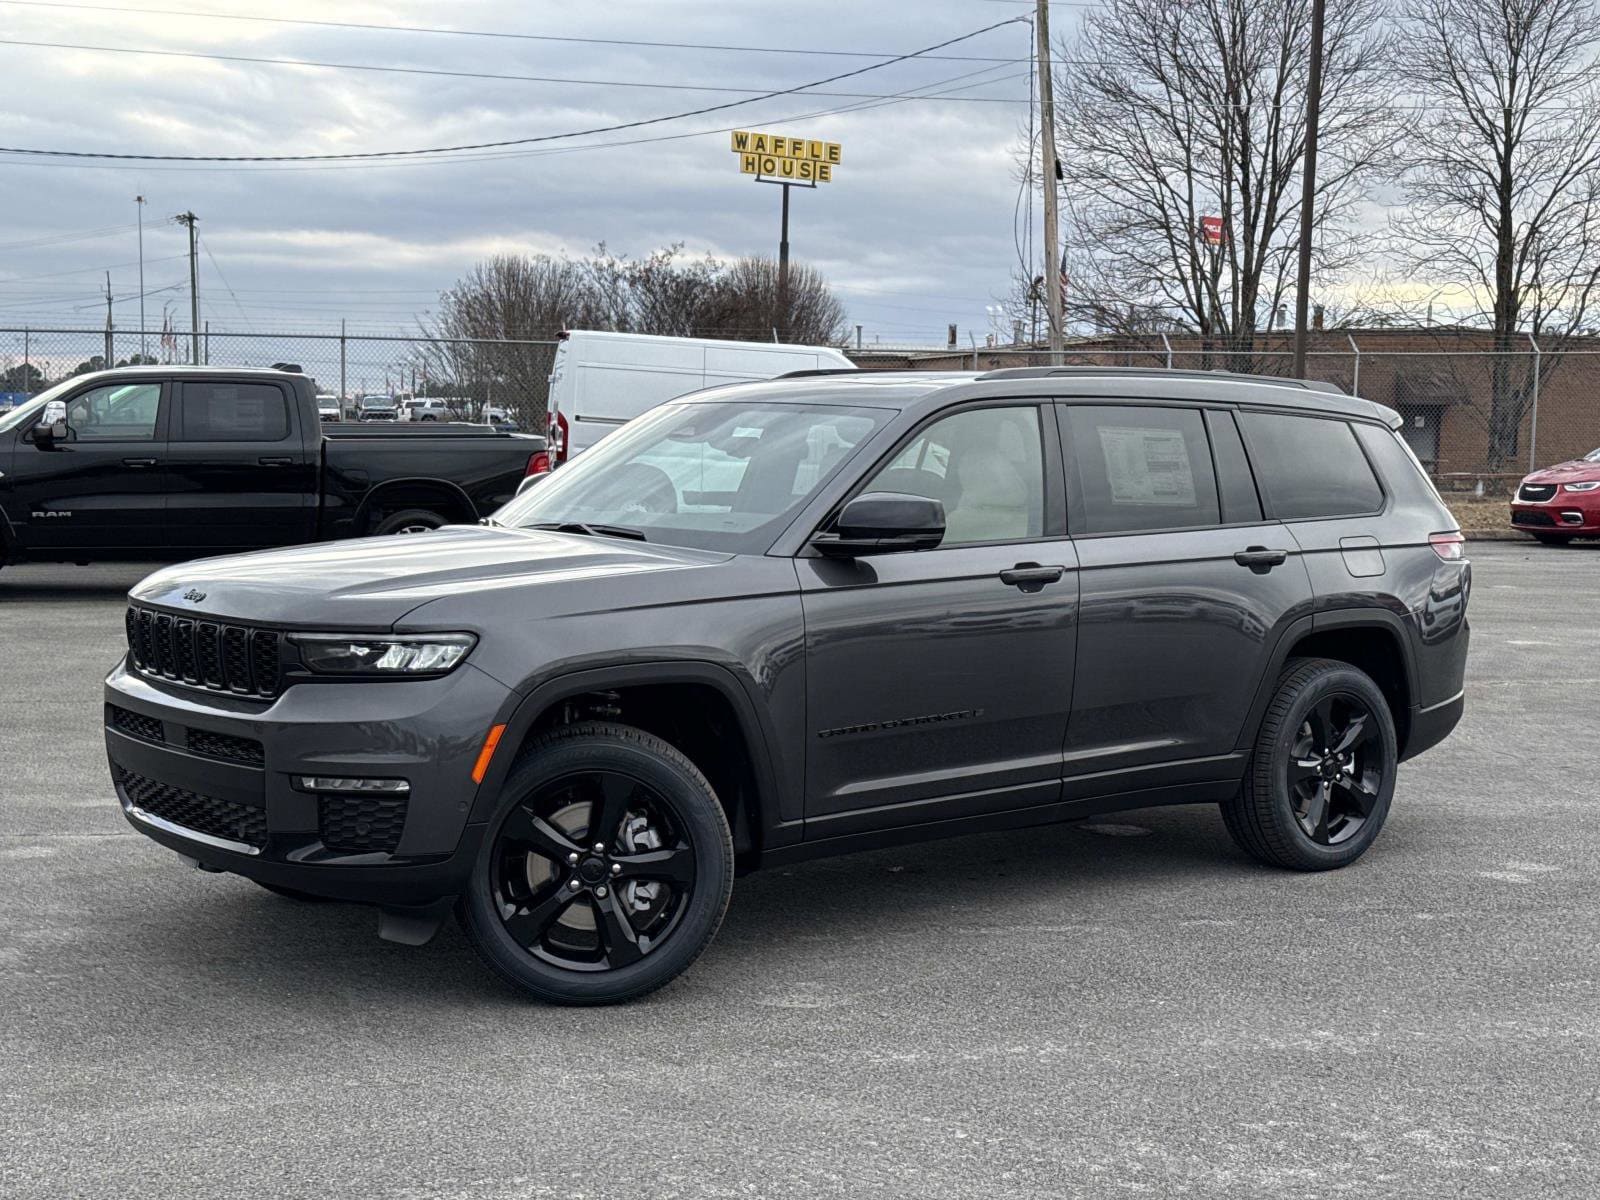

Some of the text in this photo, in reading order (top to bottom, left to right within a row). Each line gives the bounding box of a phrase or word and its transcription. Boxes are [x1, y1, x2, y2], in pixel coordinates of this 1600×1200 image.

[734, 133, 839, 161] WAFFLE
[745, 156, 829, 181] HOUSE
[183, 588, 208, 604] Jeep
